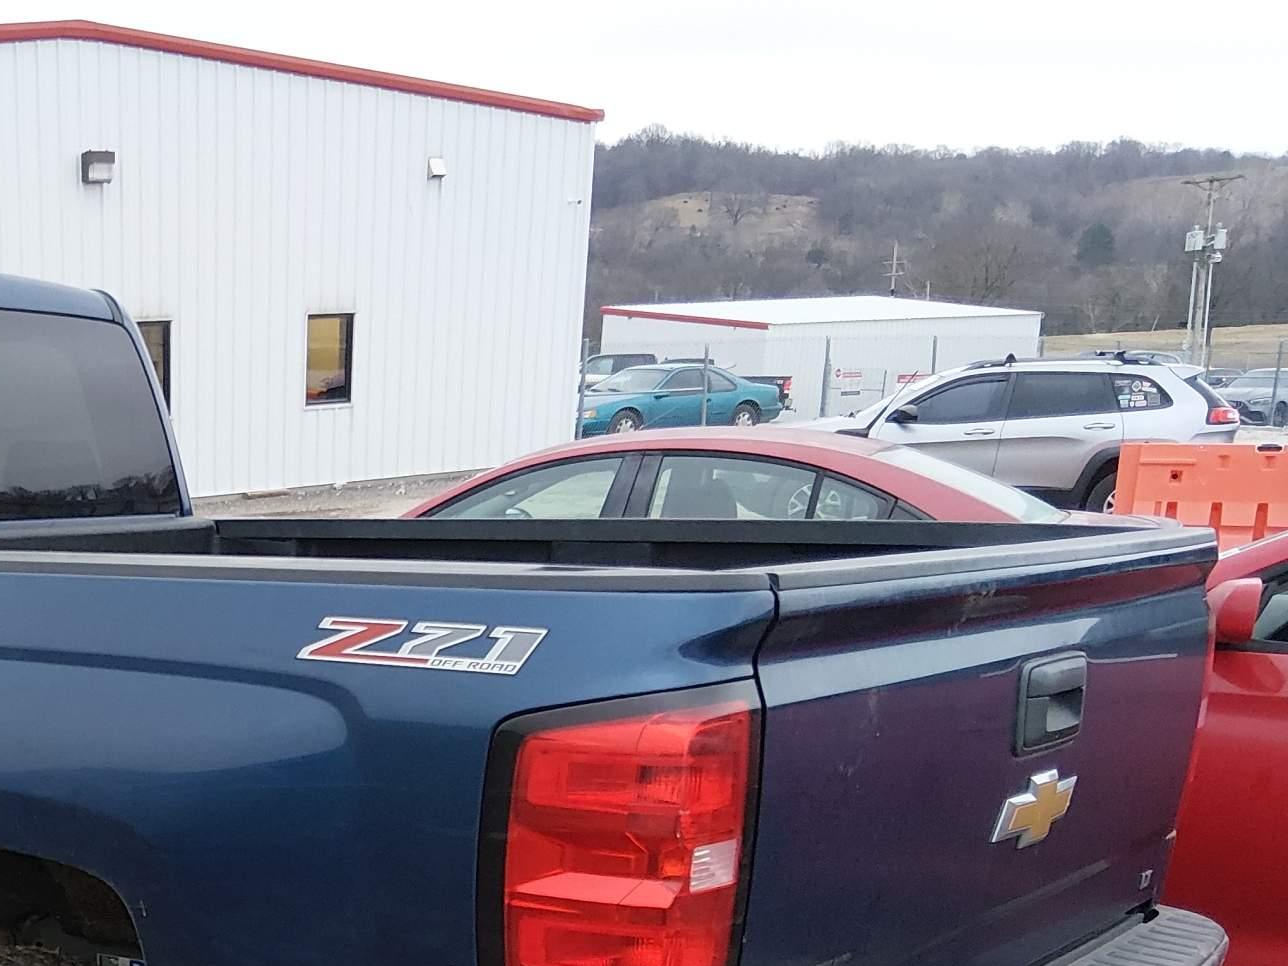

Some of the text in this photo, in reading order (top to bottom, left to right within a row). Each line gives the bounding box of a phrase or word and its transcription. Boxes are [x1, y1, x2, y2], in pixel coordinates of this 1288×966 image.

[296, 616, 549, 674] Z71
[431, 659, 518, 673] OFF ROAD
